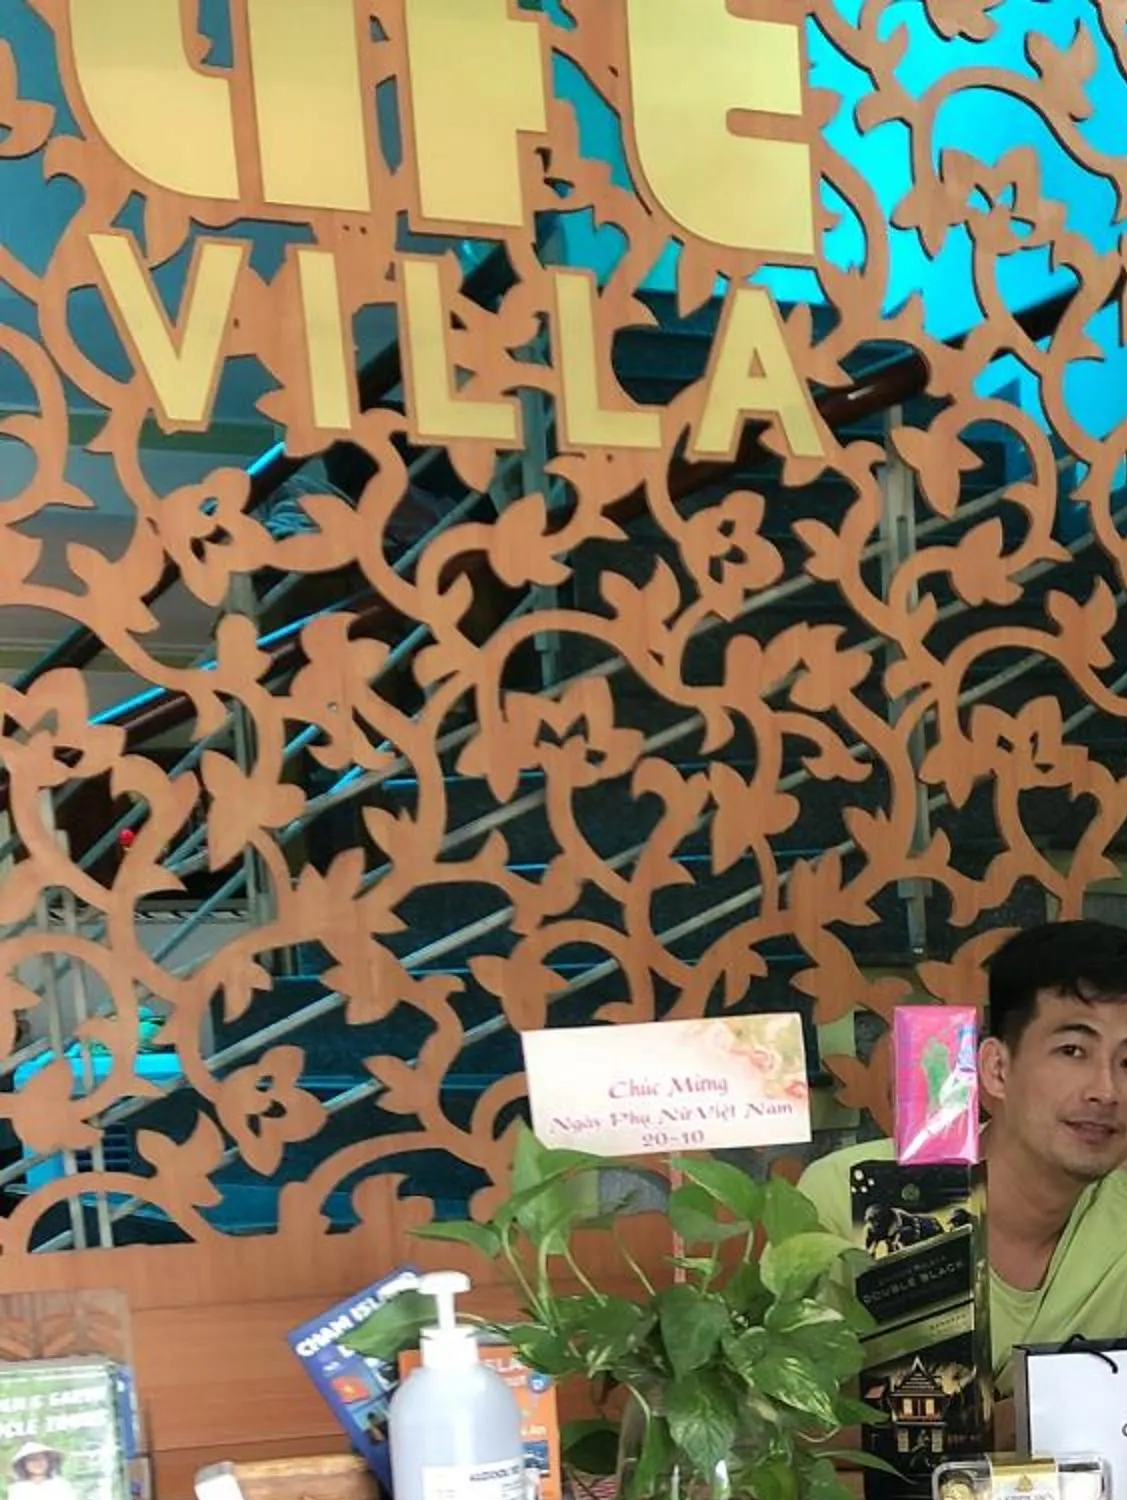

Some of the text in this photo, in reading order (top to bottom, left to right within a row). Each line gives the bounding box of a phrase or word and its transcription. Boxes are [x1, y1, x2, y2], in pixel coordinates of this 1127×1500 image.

[69, 0, 815, 254] LIFE
[88, 233, 824, 457] VILLA
[608, 1078, 659, 1099] Chúc
[609, 1110, 652, 1127] Phụ
[697, 1103, 737, 1120] Việt
[744, 1101, 793, 1119] Nam
[641, 1129, 704, 1148] 20-10
[919, 1260, 965, 1283] BLACK
[295, 1314, 355, 1357] CHAM
